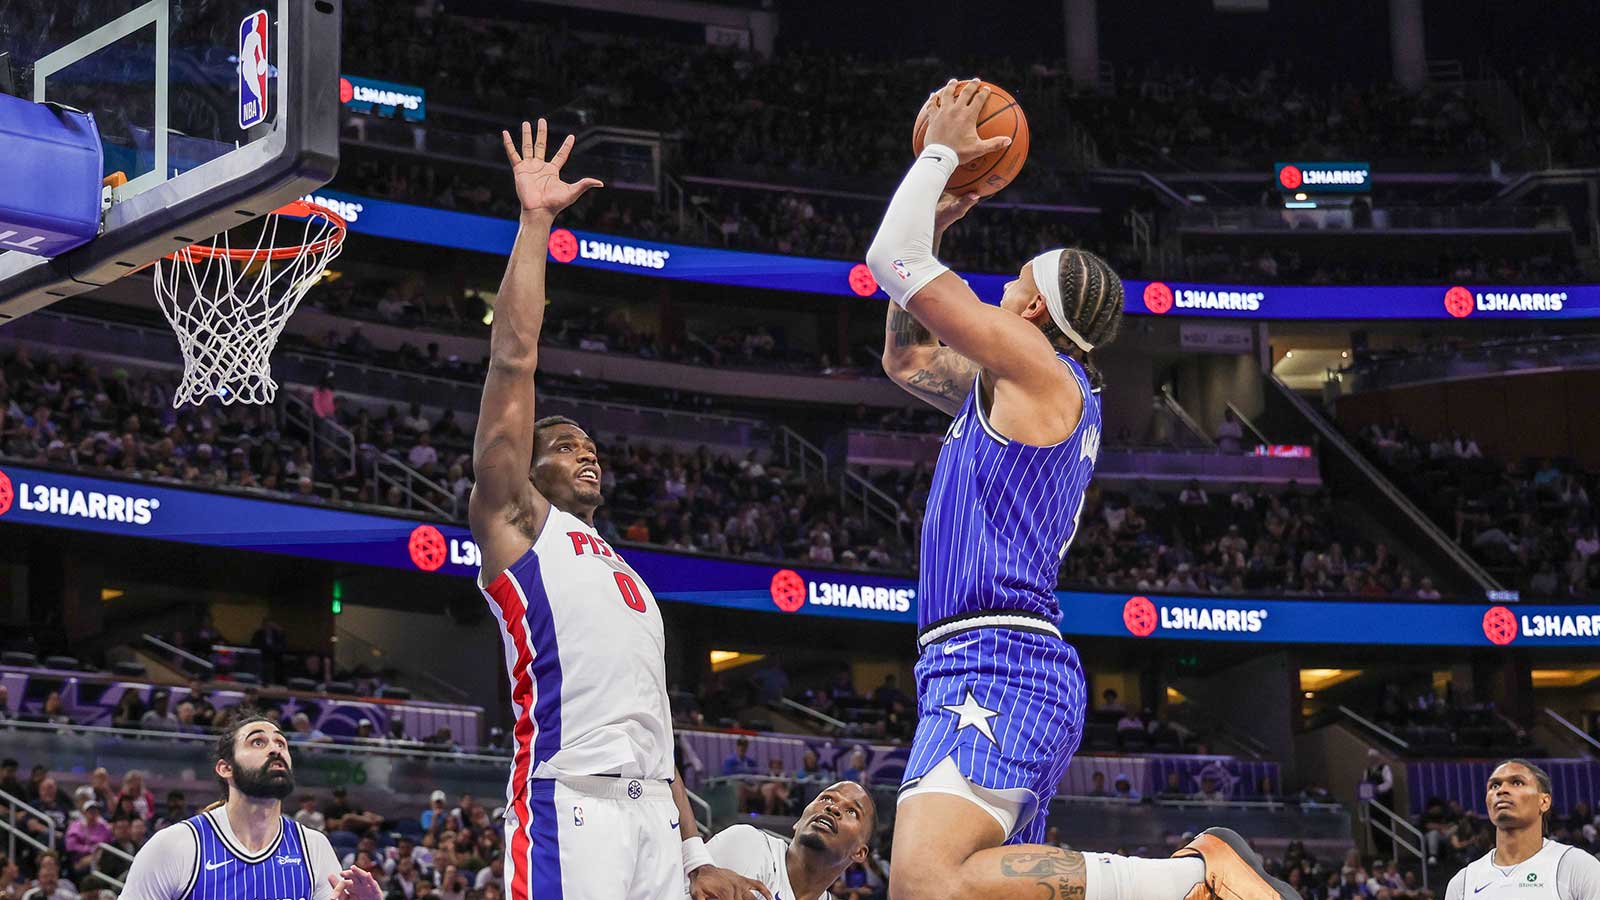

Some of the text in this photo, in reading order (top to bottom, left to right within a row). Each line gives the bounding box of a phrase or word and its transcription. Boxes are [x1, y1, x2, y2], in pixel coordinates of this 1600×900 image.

[243, 99, 257, 122] NBA
[1302, 170, 1365, 184] L3HARRIS
[580, 239, 665, 269] L3HARRIS
[1175, 291, 1260, 311] L3HARRIS
[1477, 293, 1562, 311] L3HARRIS
[19, 483, 152, 525] L3HARRIS
[566, 531, 624, 563] PIS
[613, 571, 646, 613] 0
[809, 581, 910, 612] L3HARRIS
[1161, 606, 1262, 632] L3HARRIS
